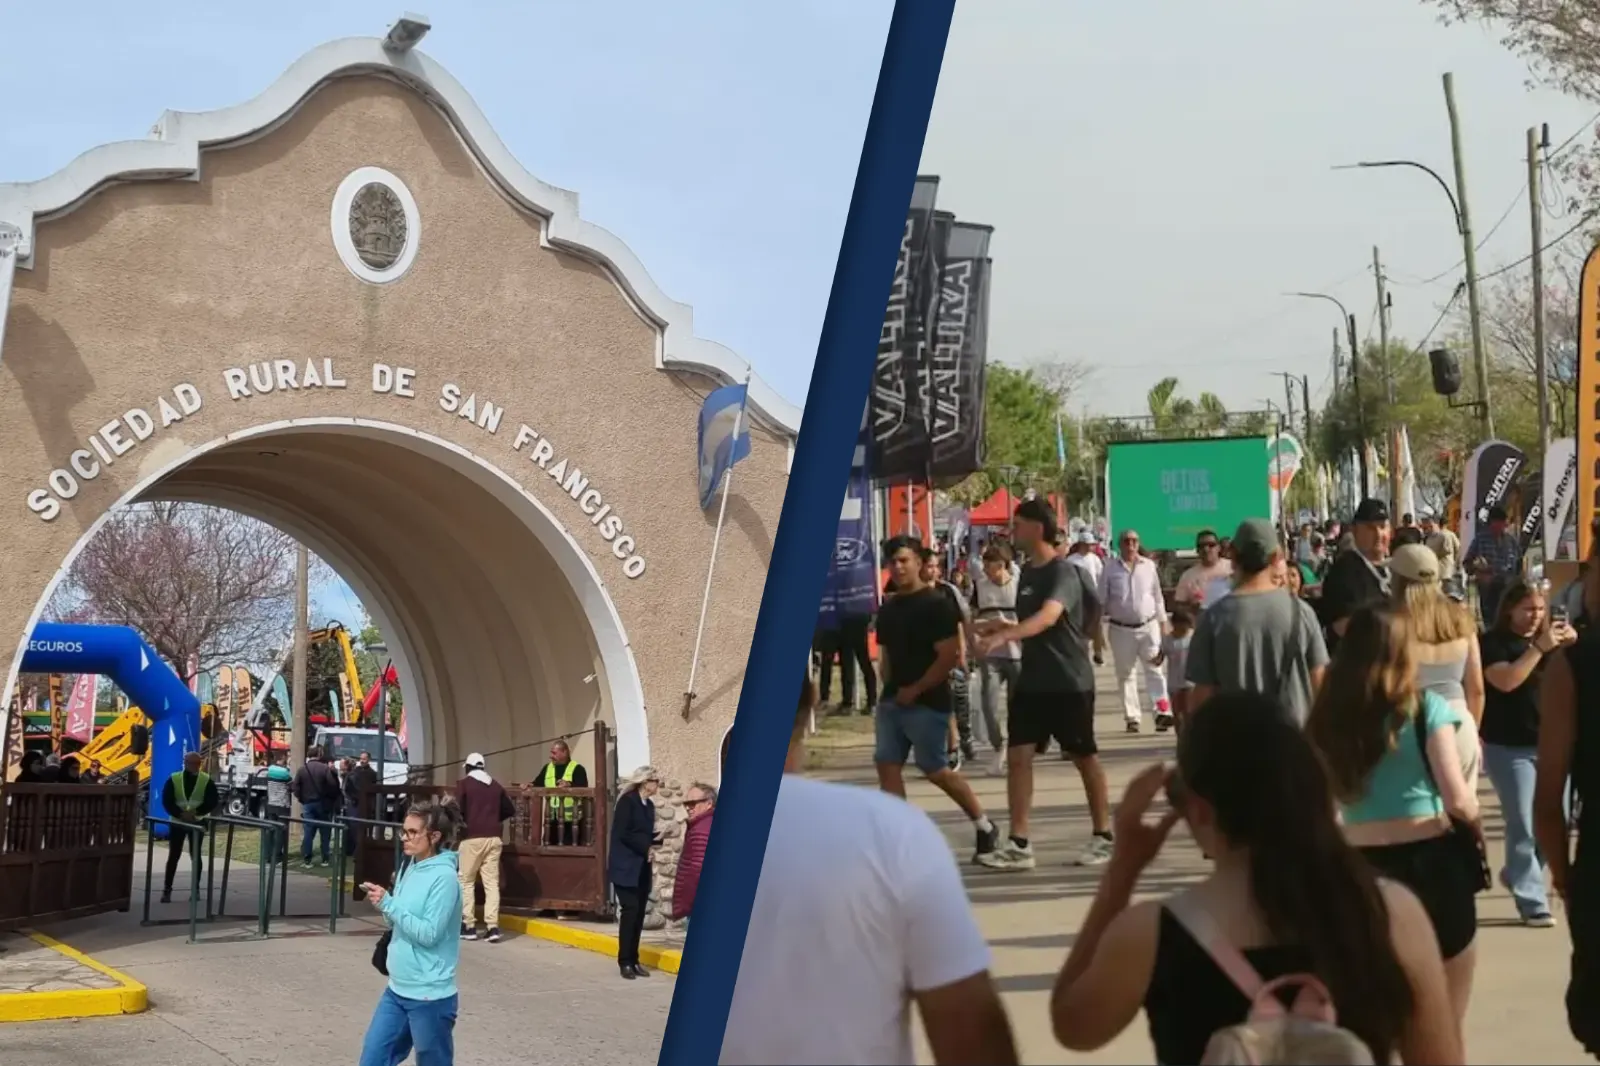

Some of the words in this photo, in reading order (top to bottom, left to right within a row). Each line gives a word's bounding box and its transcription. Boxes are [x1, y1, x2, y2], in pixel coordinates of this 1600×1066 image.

[26, 382, 203, 522] SOCIEDAD
[223, 357, 347, 400] RURAL
[371, 363, 416, 398] DE
[439, 381, 505, 434] SAN
[512, 423, 647, 581] FRANCISCO
